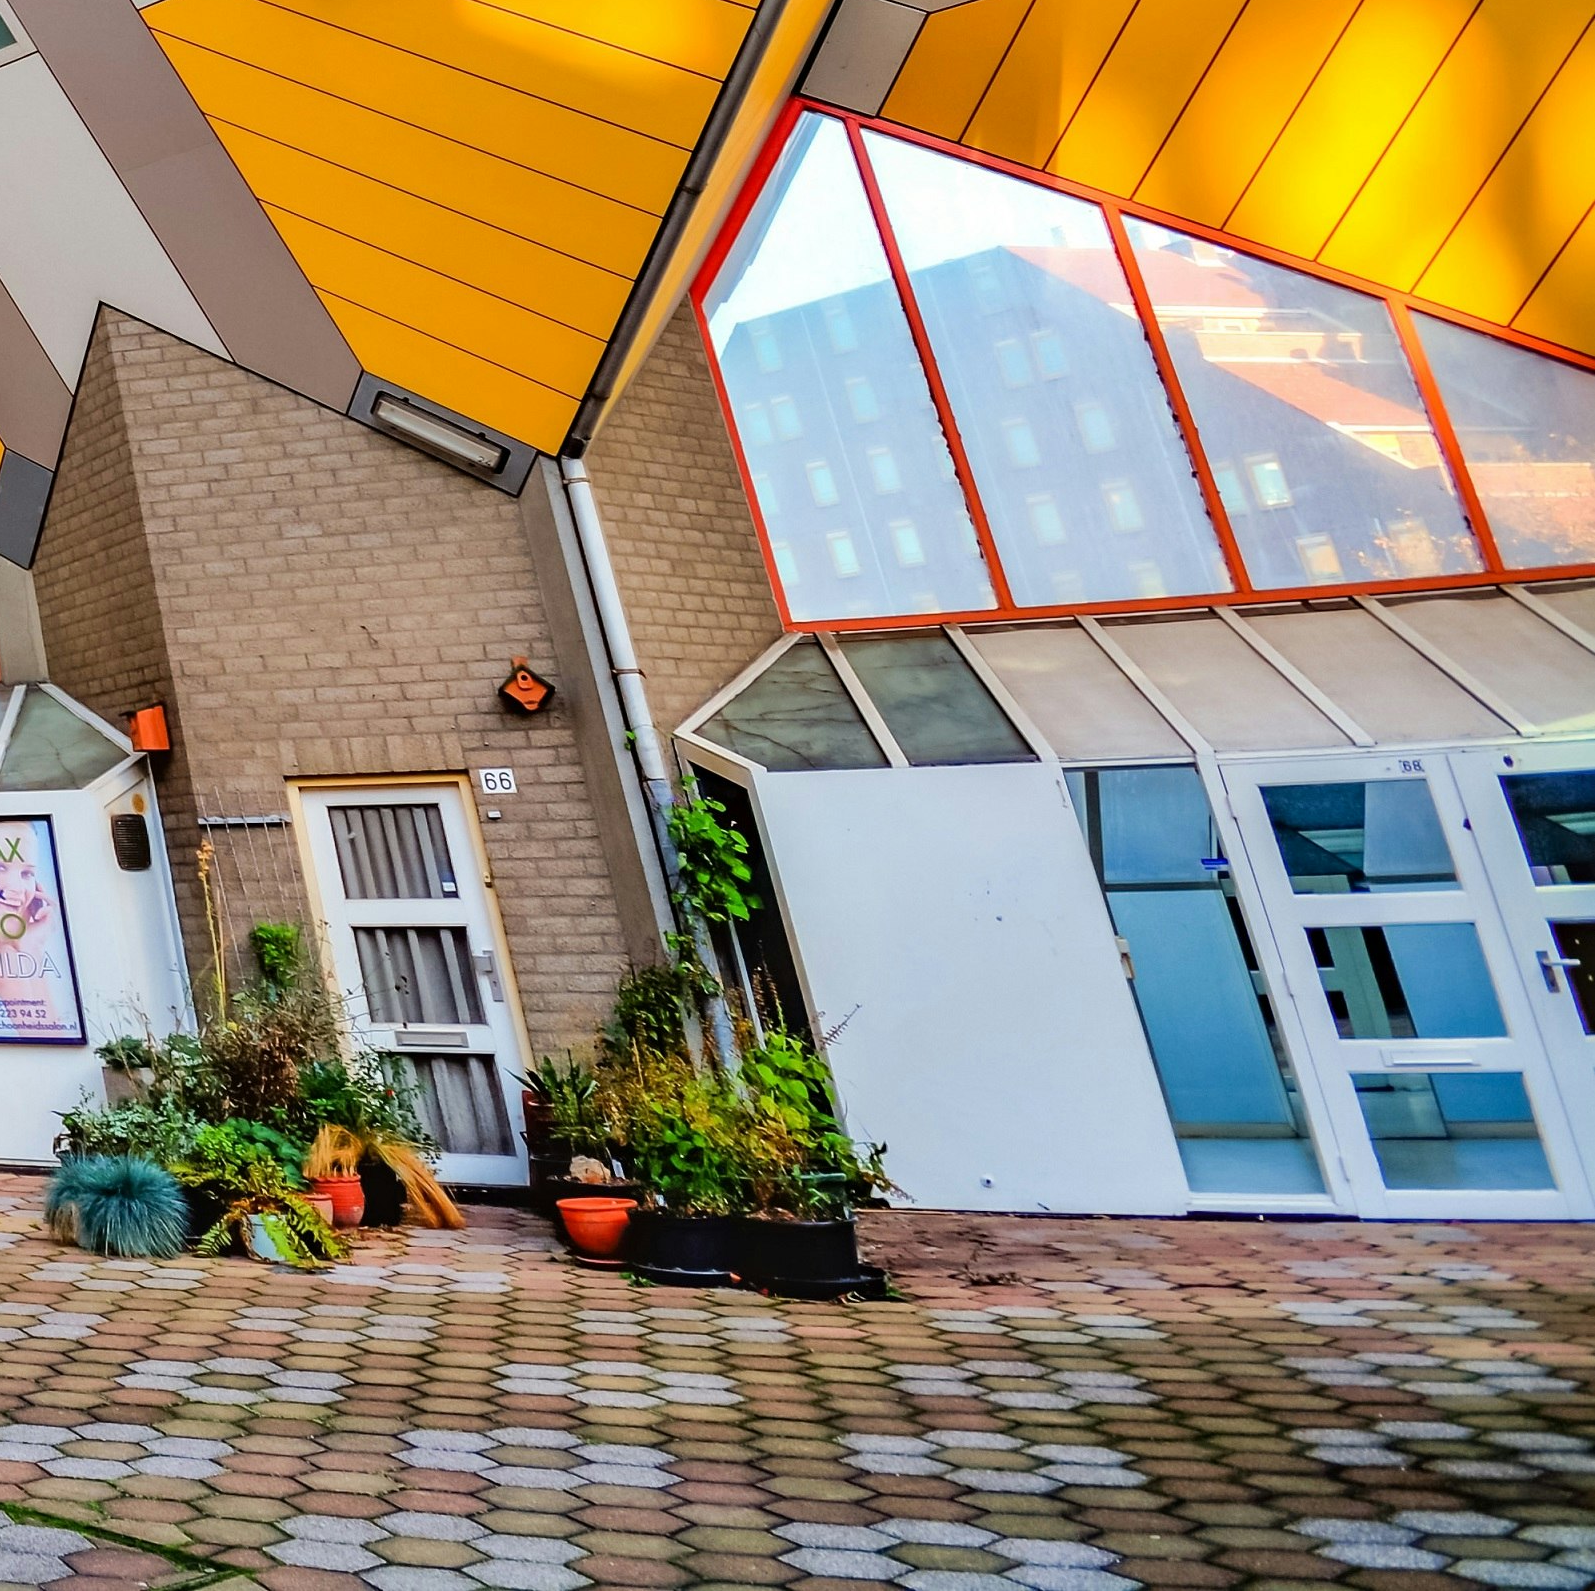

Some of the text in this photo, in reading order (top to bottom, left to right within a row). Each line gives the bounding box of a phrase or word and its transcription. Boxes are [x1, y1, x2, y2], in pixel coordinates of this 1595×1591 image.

[1402, 760, 1422, 772] 68
[484, 772, 512, 790] 66
[20, 1009, 32, 1018] 94
[35, 1009, 47, 1018] 52
